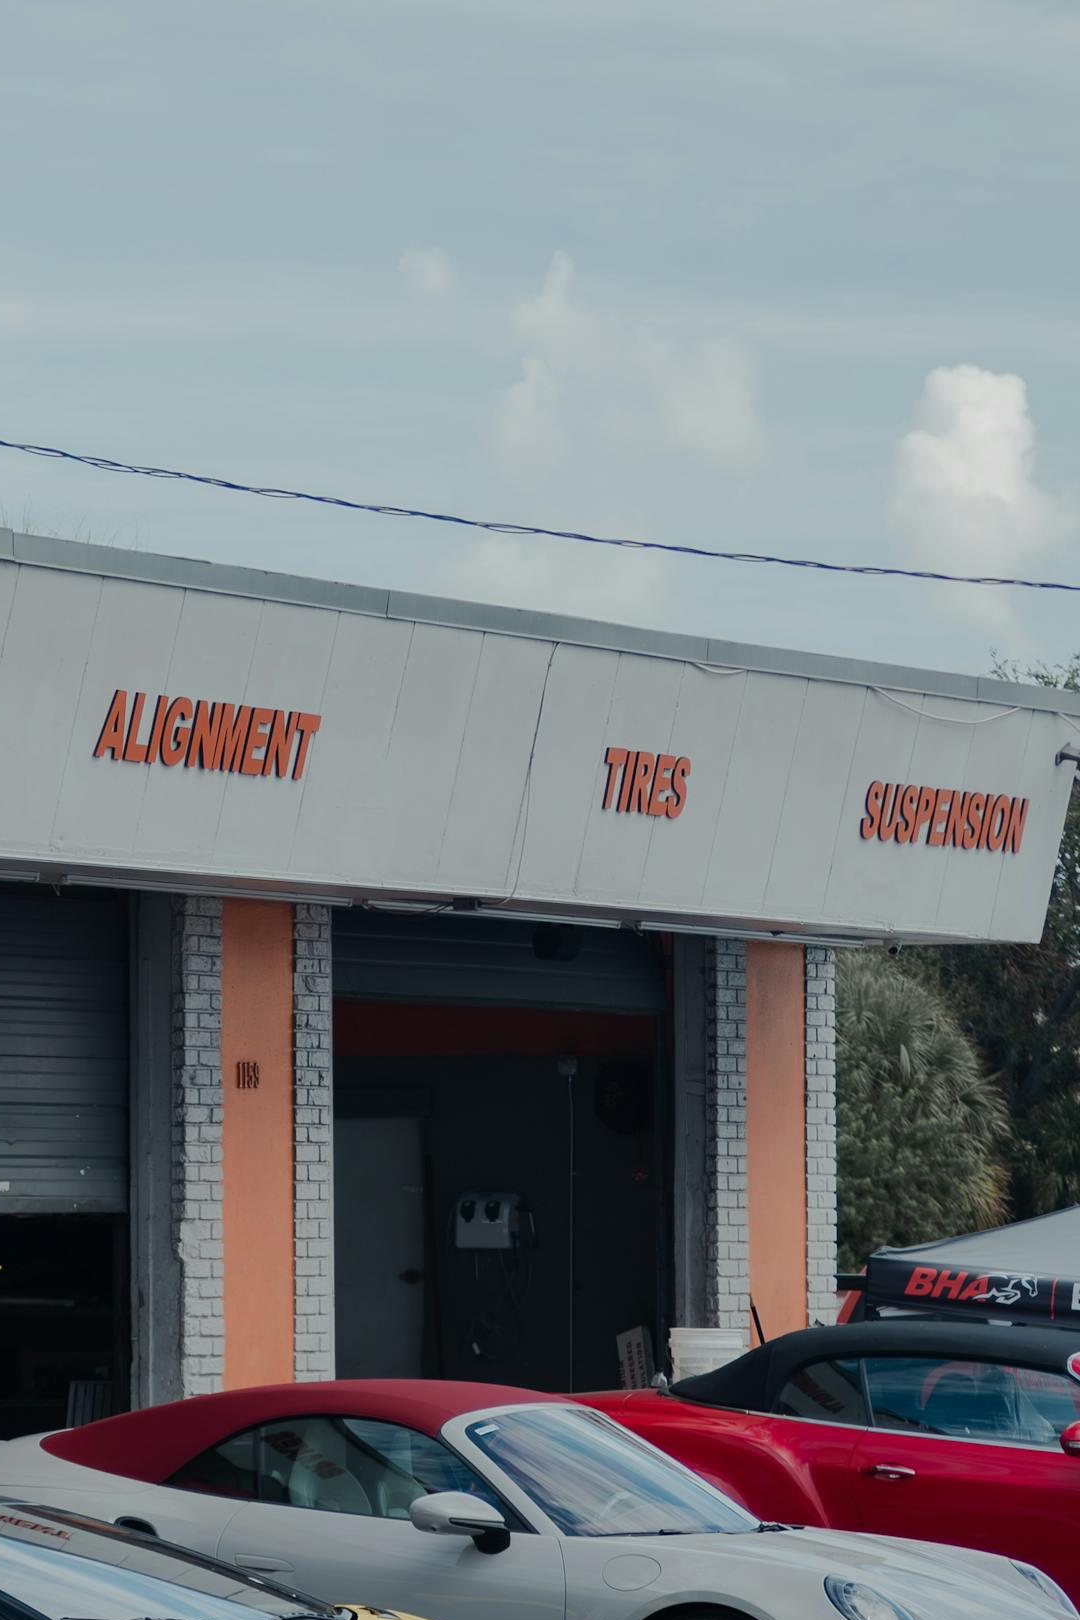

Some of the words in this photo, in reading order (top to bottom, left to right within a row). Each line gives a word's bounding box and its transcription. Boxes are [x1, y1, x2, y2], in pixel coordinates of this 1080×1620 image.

[93, 689, 320, 780] ALIGNMENT
[602, 747, 691, 819] TIRES
[860, 780, 1029, 853] SUSPENSION
[904, 1267, 990, 1302] BHA
